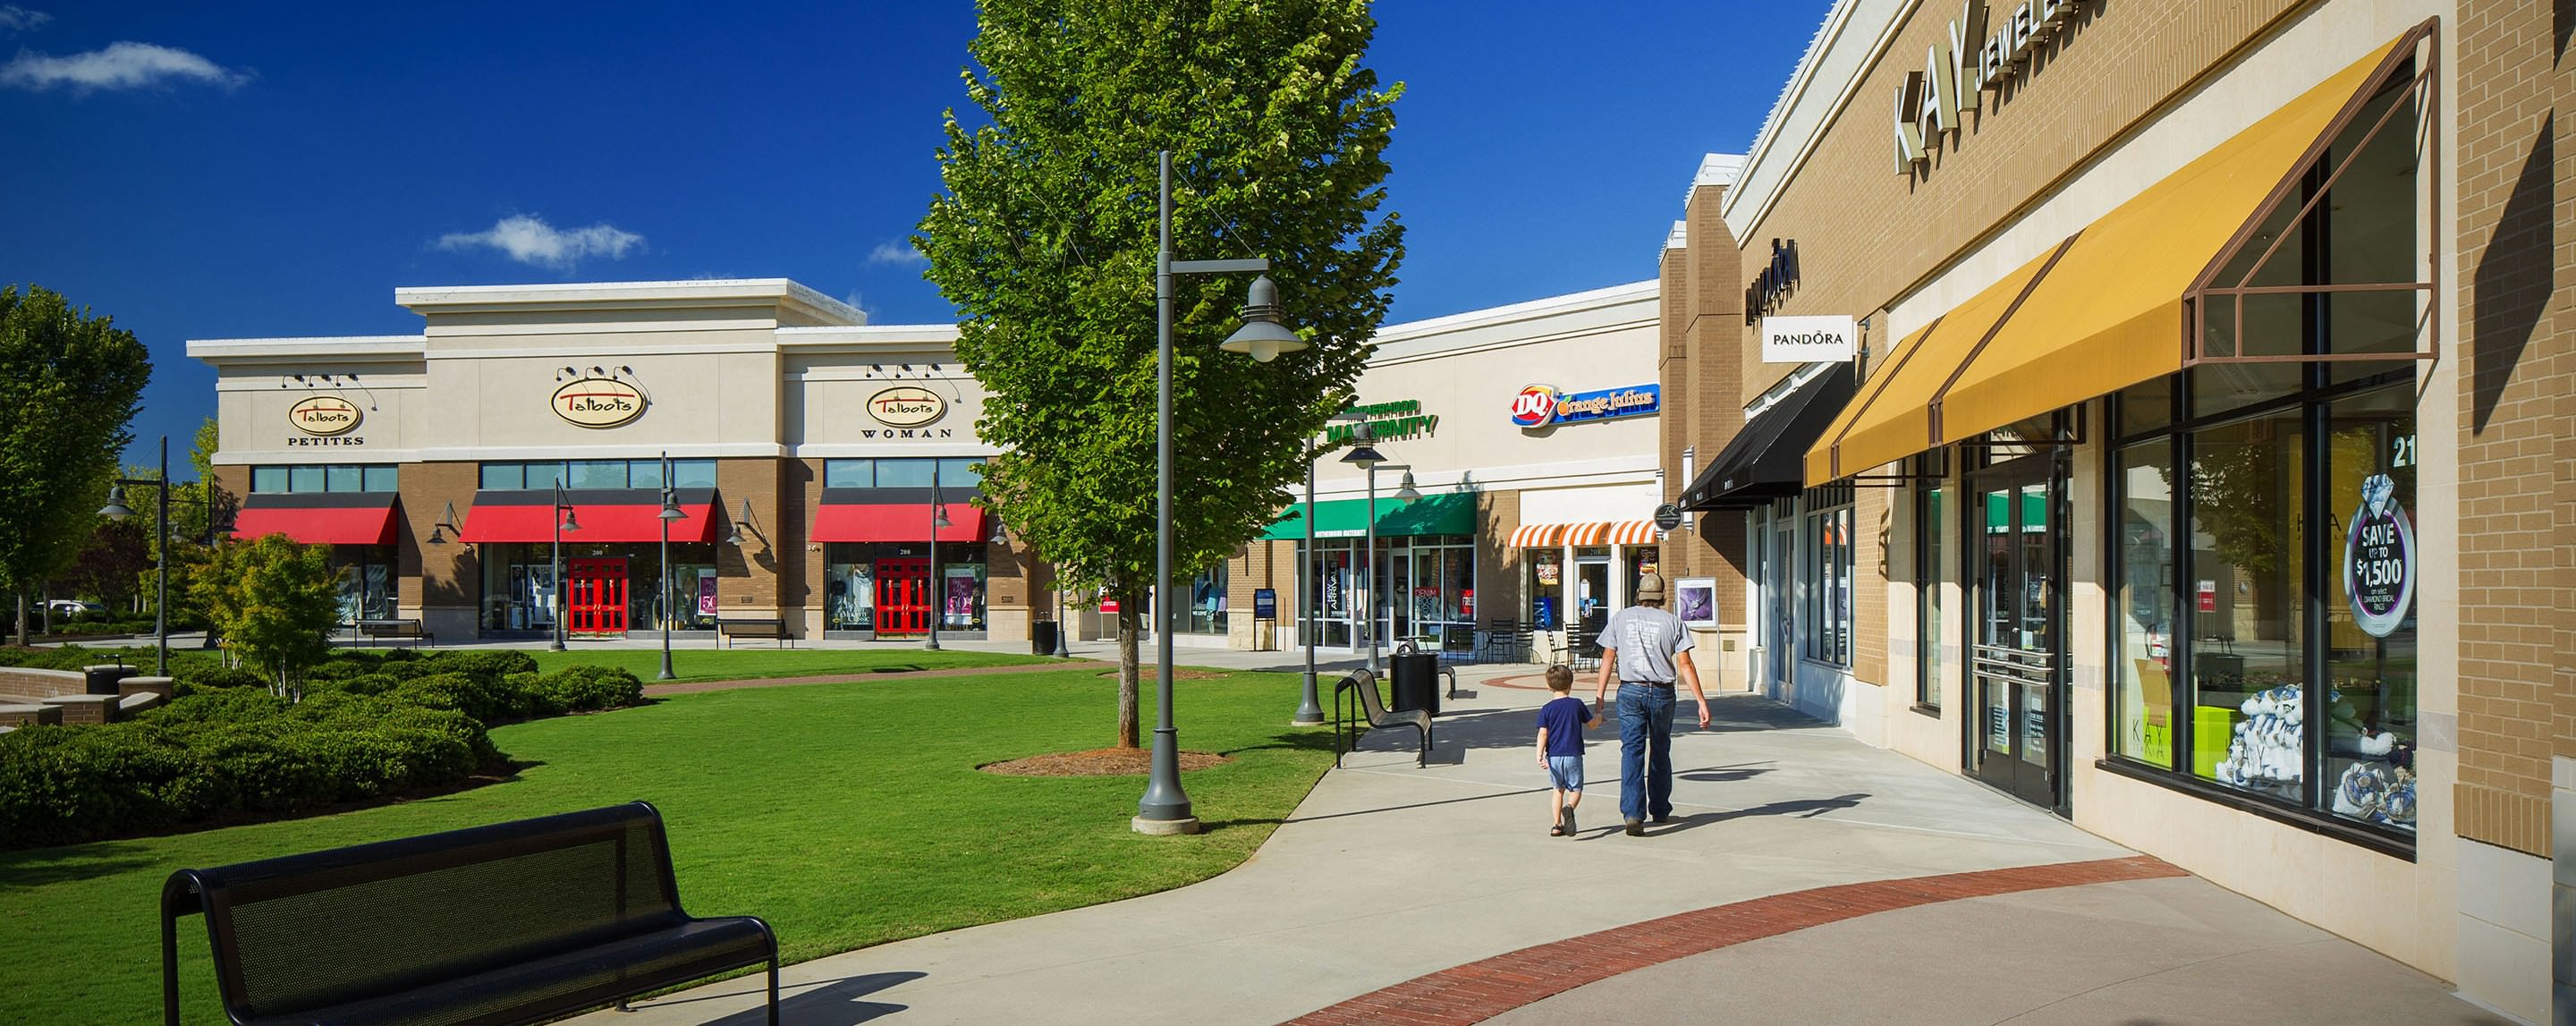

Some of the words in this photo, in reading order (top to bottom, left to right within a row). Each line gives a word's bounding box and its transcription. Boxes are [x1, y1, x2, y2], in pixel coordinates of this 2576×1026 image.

[1975, 0, 2072, 91] JEWELE
[1894, 0, 1984, 175] KAY
[559, 393, 636, 411] Talbots
[874, 398, 936, 413] Talbots
[1607, 390, 1655, 411] Julius
[296, 408, 352, 421] Talbots
[861, 428, 952, 438] WOMAN
[1326, 415, 1437, 443] MAERNITY
[287, 437, 364, 445] PETITES
[2362, 523, 2394, 547] SAVE
[2368, 547, 2378, 558] UP
[2378, 547, 2388, 558] TO
[2132, 719, 2163, 746] KAY
